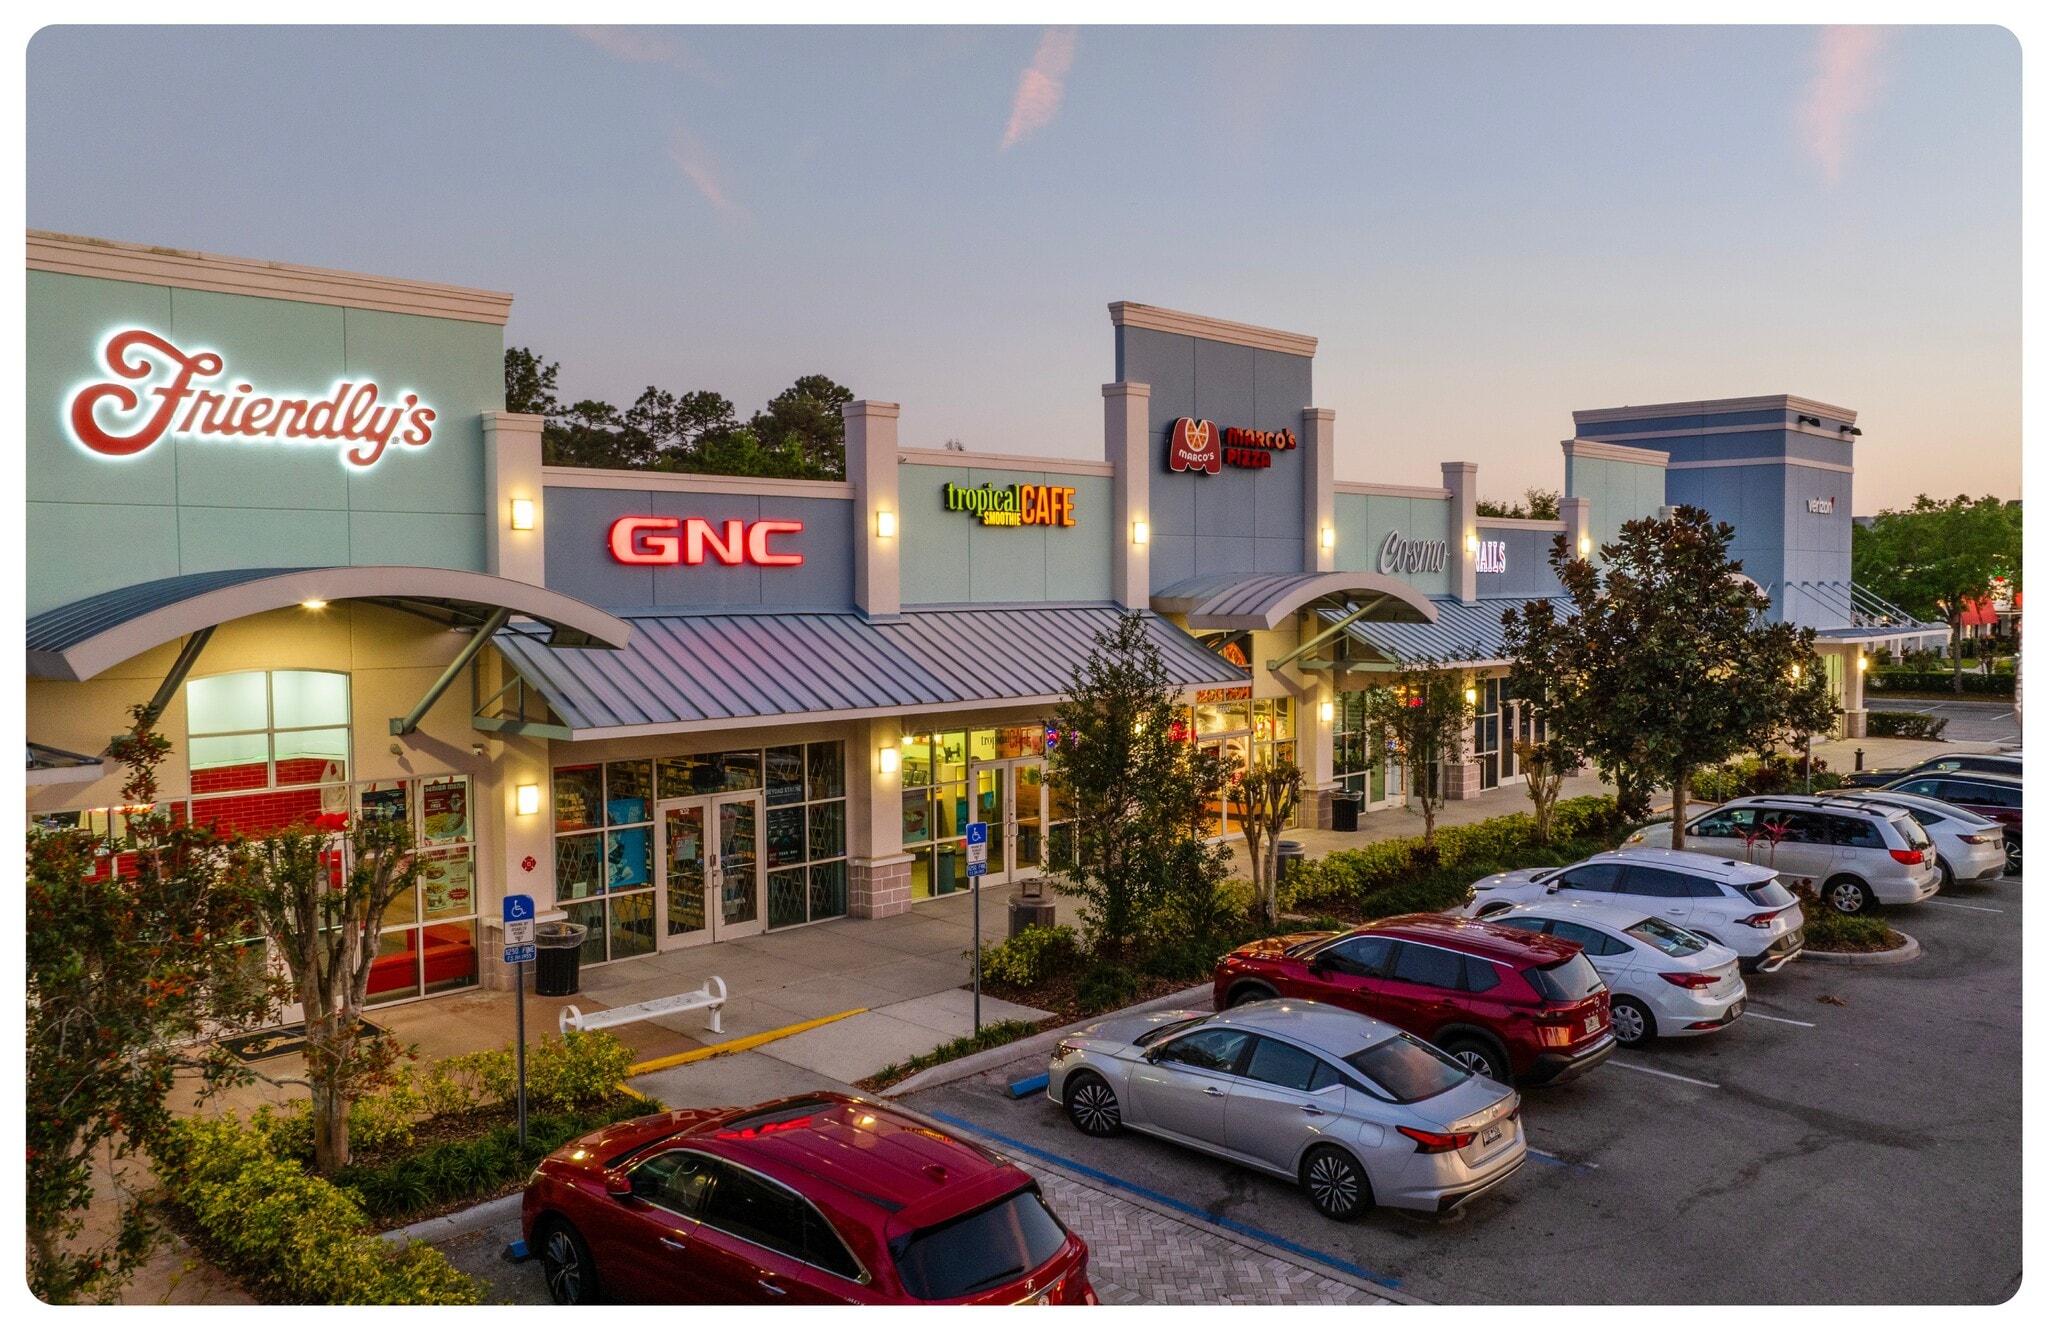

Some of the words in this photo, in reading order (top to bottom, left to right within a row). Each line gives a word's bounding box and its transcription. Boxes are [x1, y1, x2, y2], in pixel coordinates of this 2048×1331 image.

[71, 329, 437, 466] Friendly's
[1178, 449, 1215, 462] MARCO'S
[946, 482, 1021, 517] tropical
[1021, 484, 1076, 527] CAFE
[983, 511, 1021, 526] SMOOTHIE
[1807, 496, 1834, 514] verizon
[608, 516, 804, 566] GNC
[1378, 529, 1451, 575] Cosmo
[1009, 728, 1032, 749] CAFE
